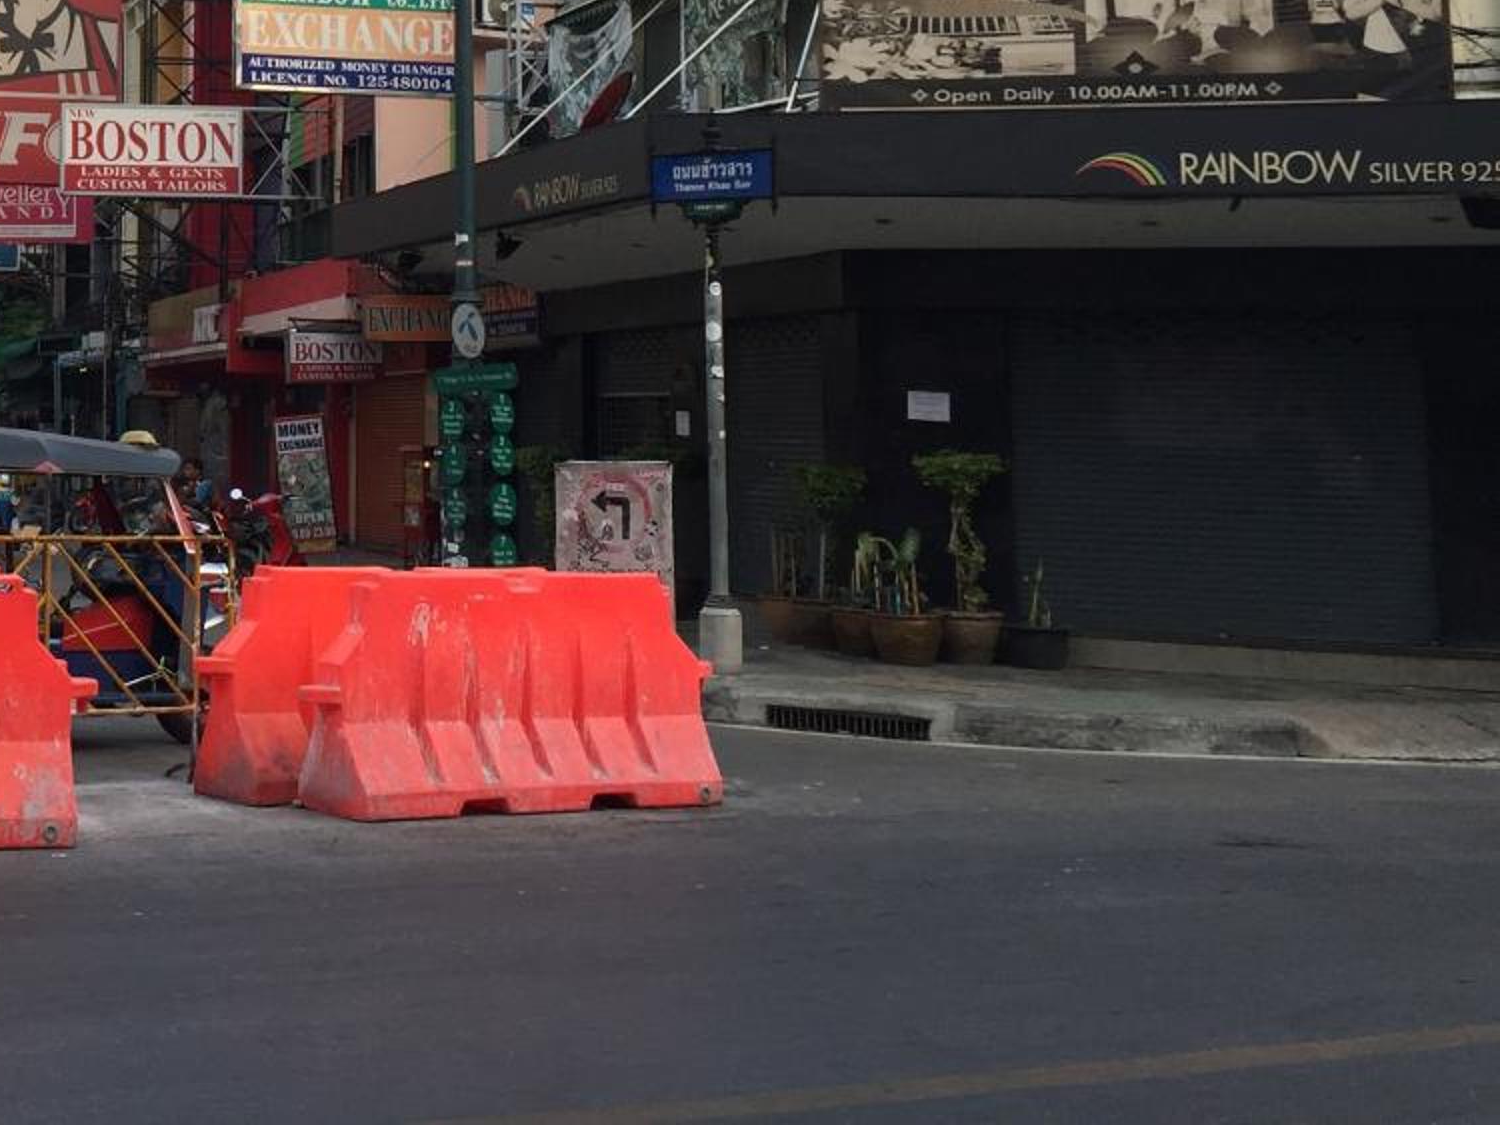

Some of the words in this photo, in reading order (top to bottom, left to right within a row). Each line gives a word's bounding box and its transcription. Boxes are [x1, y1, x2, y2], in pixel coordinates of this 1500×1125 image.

[250, 9, 455, 57] EXCHANGE
[248, 56, 336, 71] AUTHORIZED
[341, 61, 388, 75] MONEY
[392, 64, 455, 76] CHANGER
[251, 71, 317, 85] LICENCE
[933, 88, 992, 105] Open
[1003, 86, 1055, 103] Daily
[68, 119, 236, 164] BOSTON
[80, 165, 140, 178] LADIES
[148, 167, 160, 178] &
[169, 167, 223, 179] GENTS
[672, 157, 754, 180] ถนนข้าวสาร
[1179, 150, 1363, 185] RAINBOW
[1369, 161, 1455, 183] SILVER
[76, 177, 147, 191] CUSTOM
[154, 179, 228, 192] TAILORS
[294, 341, 378, 363] BOSTON
[277, 422, 320, 438] MONEY
